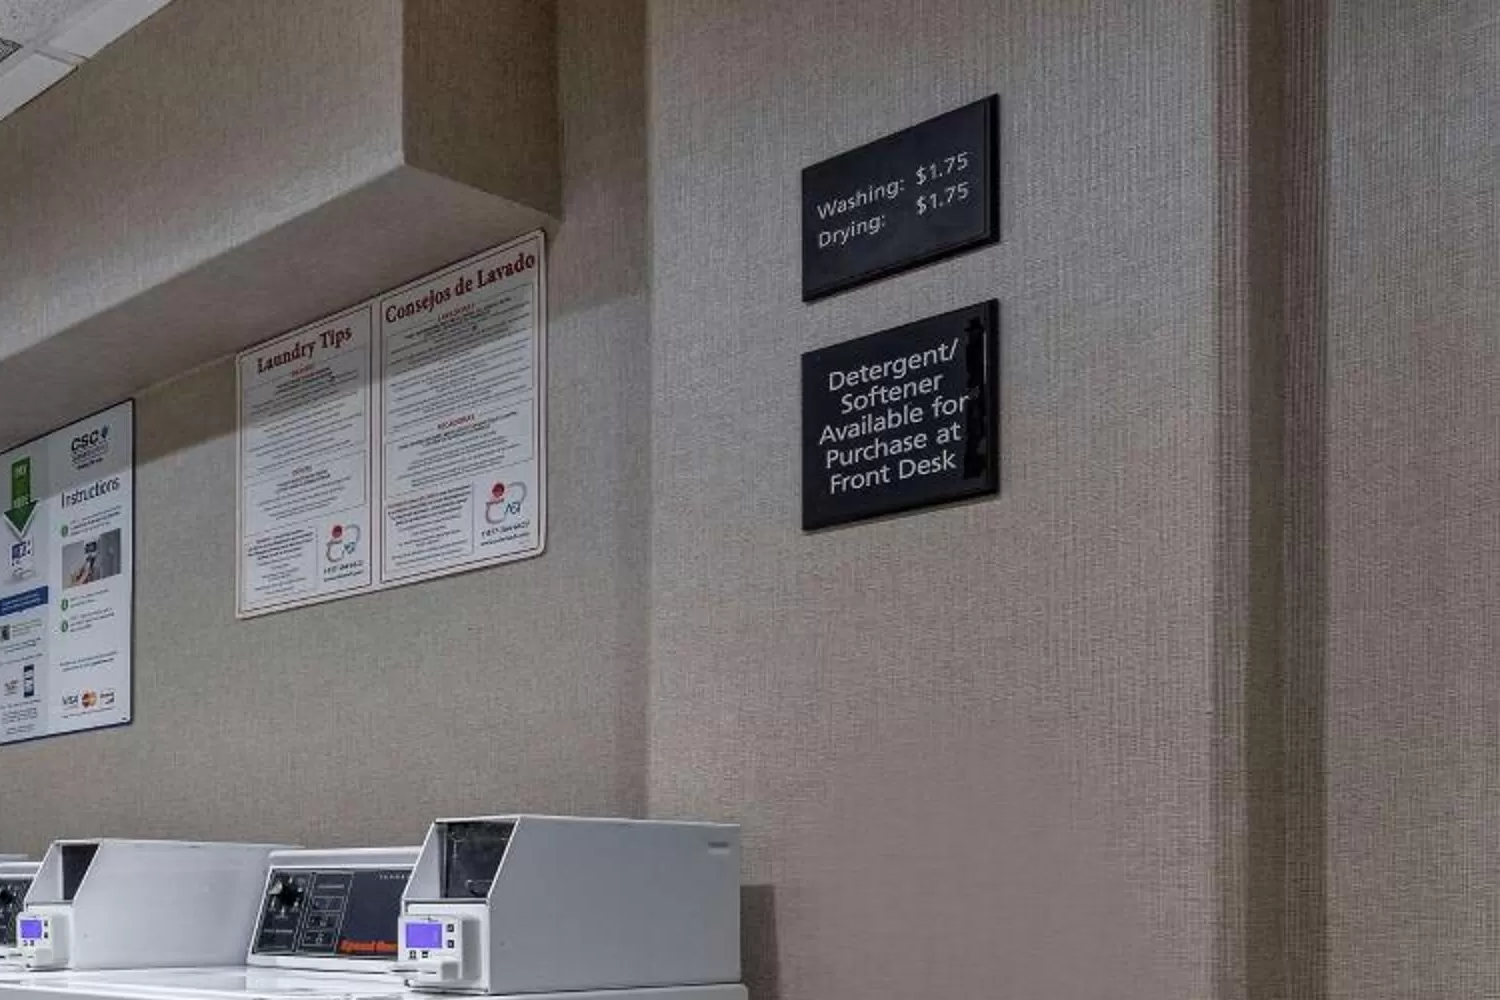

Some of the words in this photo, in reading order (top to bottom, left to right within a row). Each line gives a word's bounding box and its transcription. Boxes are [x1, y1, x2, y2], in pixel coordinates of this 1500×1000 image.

[816, 178, 904, 220] Washing:
[915, 151, 971, 185] $1.75
[818, 214, 886, 248] Drying:
[915, 181, 969, 216] $1.75
[385, 286, 452, 323] Consejos
[454, 272, 473, 298] de
[476, 252, 536, 290] Lavado
[257, 341, 317, 374] Laundry
[319, 327, 353, 349] Tips
[829, 337, 959, 391] Detergent/
[841, 374, 944, 415] Softener
[819, 403, 924, 445] Available
[932, 394, 970, 418] for
[827, 431, 928, 469] Purchase
[936, 421, 963, 445] at
[61, 476, 121, 509] Instructions
[830, 463, 892, 495] Front
[899, 449, 957, 480] Desk
